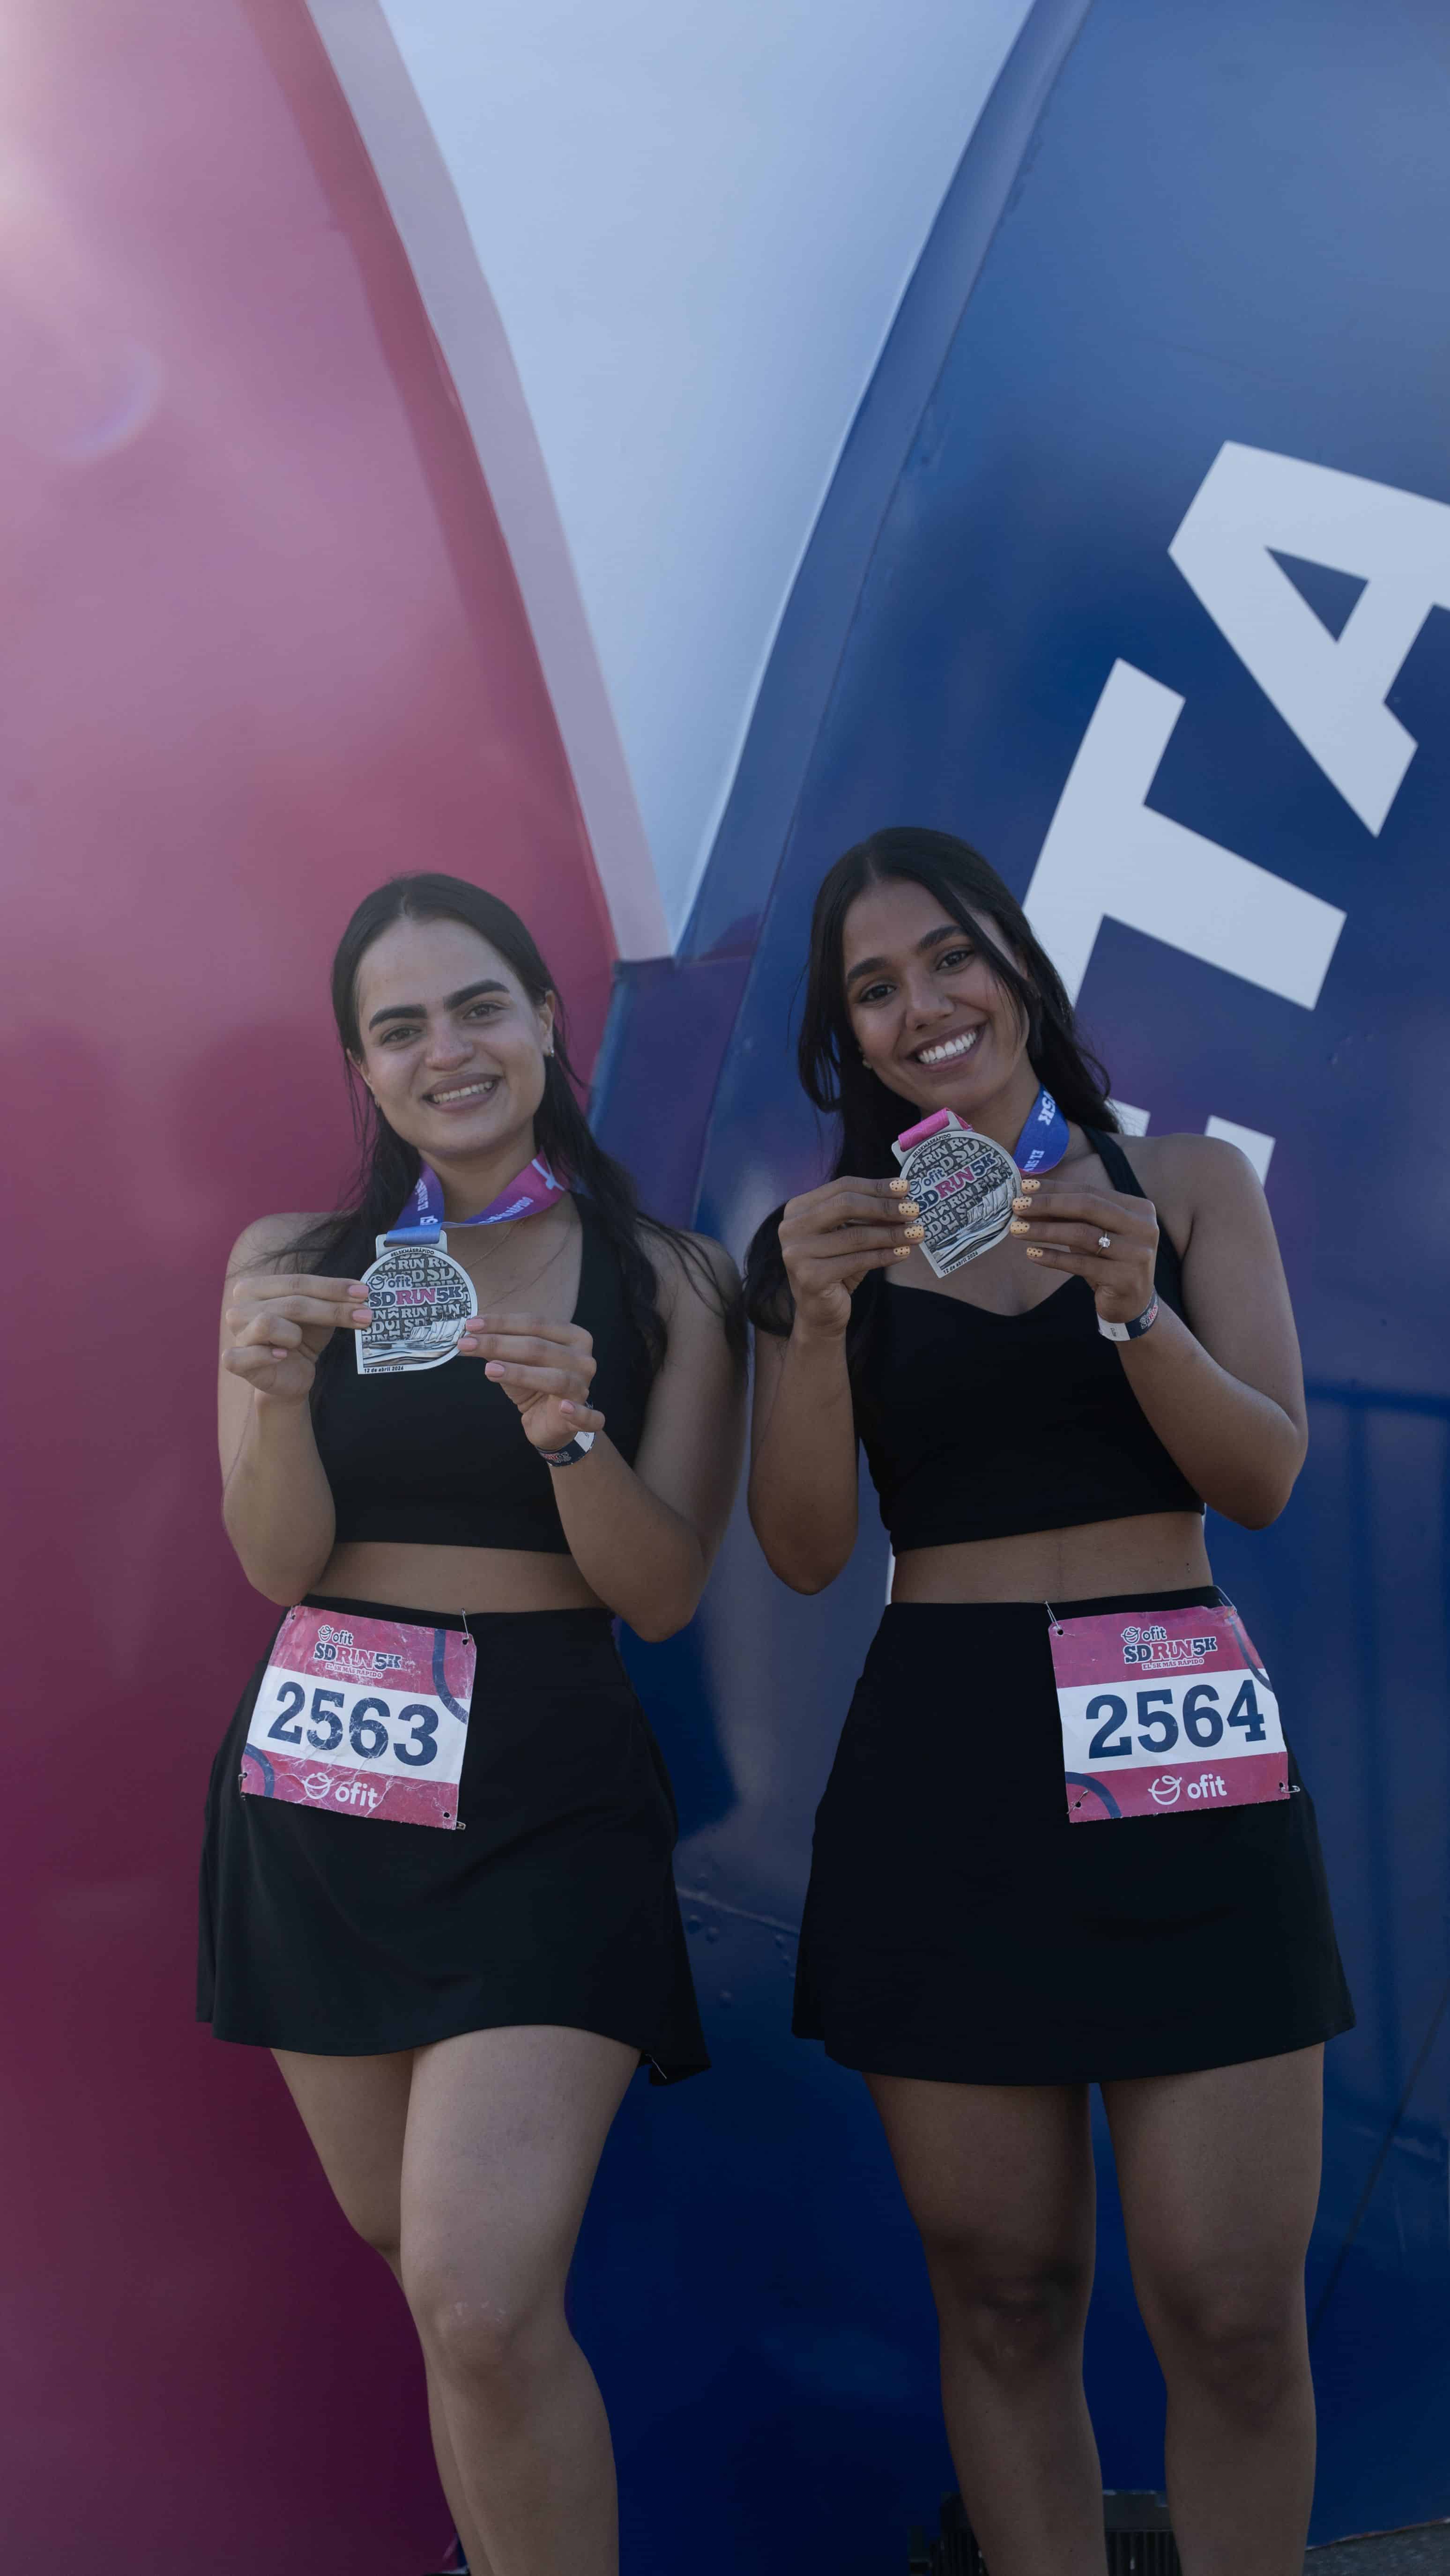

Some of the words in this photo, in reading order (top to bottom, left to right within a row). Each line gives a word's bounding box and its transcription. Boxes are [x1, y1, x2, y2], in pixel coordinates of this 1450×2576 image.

[923, 1168, 945, 1186] ofit
[388, 1276, 412, 1288] ofit
[370, 1286, 462, 1307] SDRUN5K
[333, 1631, 353, 1645] ofit
[1142, 1626, 1167, 1640] ofit
[314, 1643, 402, 1670] SDRUN5K
[1124, 1637, 1217, 1663] SDRUN5K
[267, 1680, 439, 1766] 2563
[1085, 1679, 1266, 1760] 2564
[335, 1782, 378, 1808] ofit
[1187, 1774, 1227, 1799] ofit
